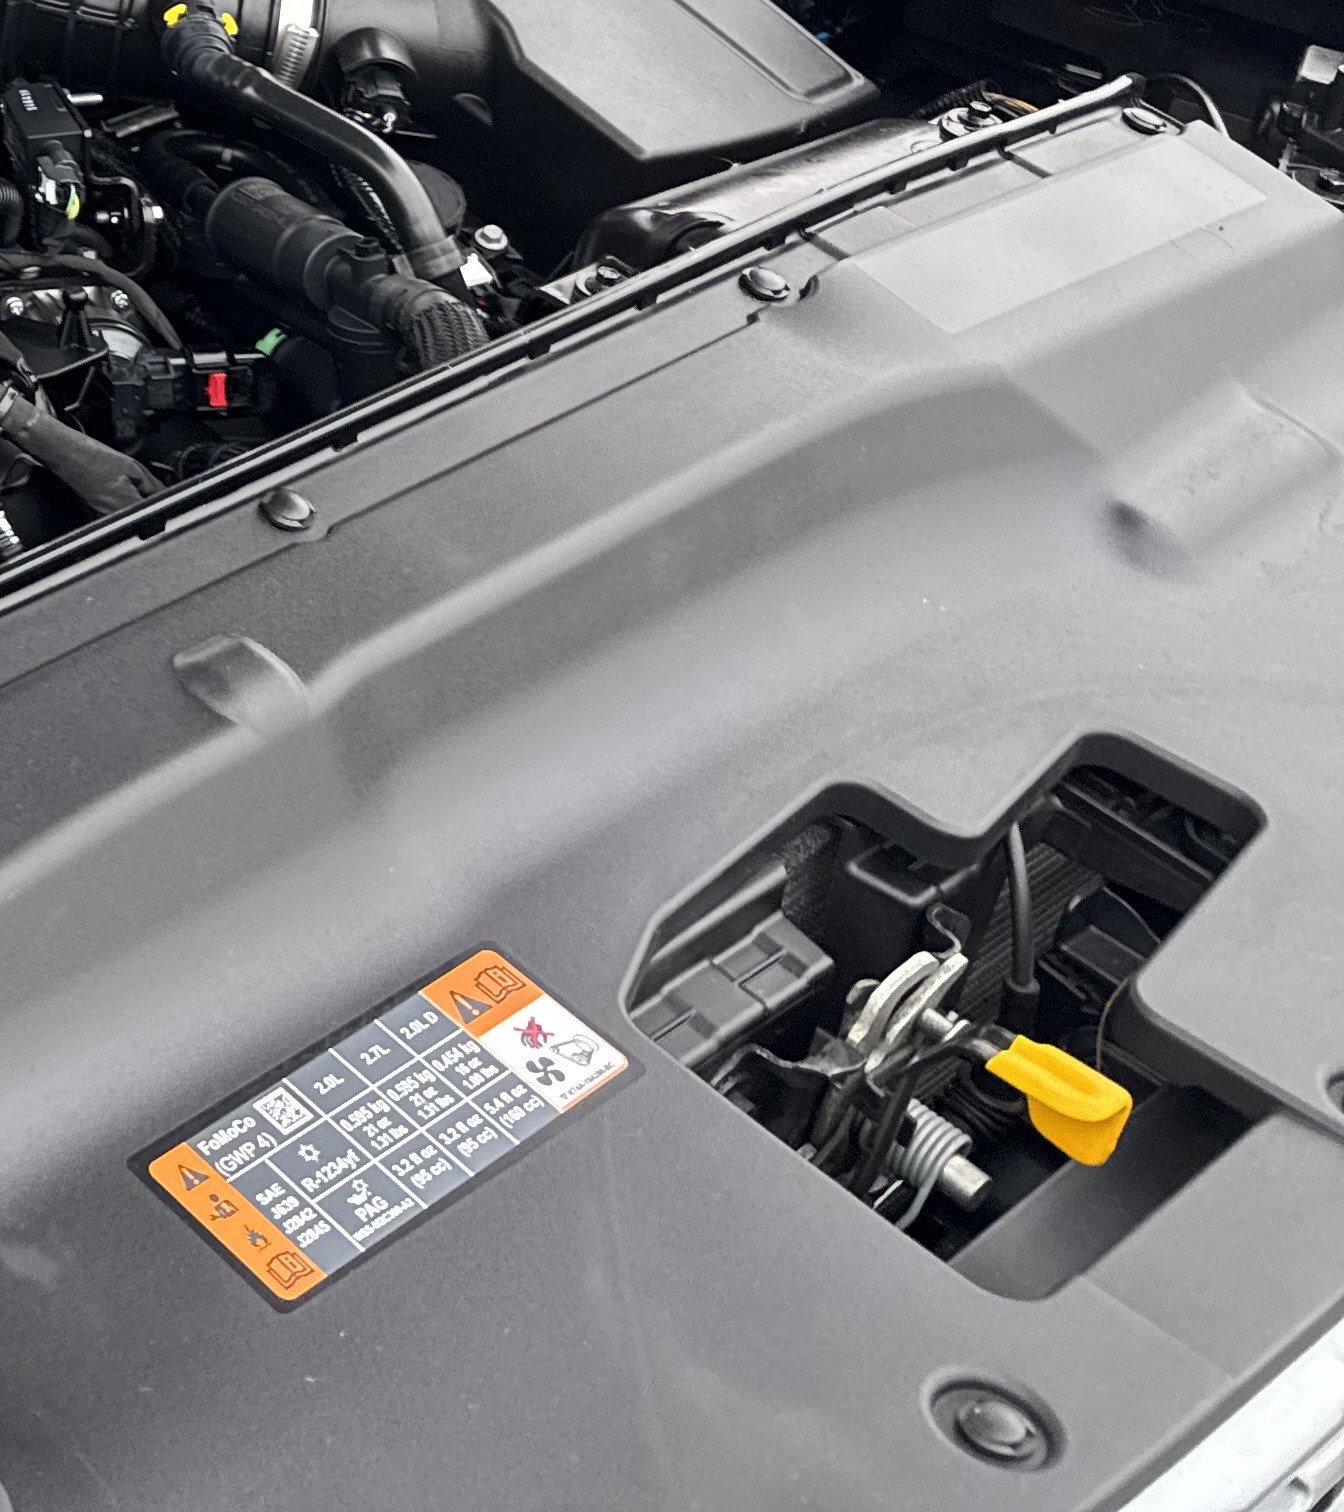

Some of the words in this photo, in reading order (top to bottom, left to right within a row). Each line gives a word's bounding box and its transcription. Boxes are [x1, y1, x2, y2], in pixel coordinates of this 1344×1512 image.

[422, 1011, 439, 1025] D
[359, 1044, 391, 1065] 2.7L
[431, 1049, 462, 1072] 0.454
[457, 1040, 481, 1055] kg
[313, 1074, 345, 1096] 2.0L
[411, 1069, 436, 1084] kg
[510, 1083, 528, 1098] oz
[366, 1098, 391, 1114] kg
[522, 1095, 545, 1113] cc)
[377, 1116, 393, 1130] oz
[438, 1127, 461, 1145] 3.2
[466, 1113, 484, 1128] oz
[197, 1116, 257, 1156] FoMoCo
[457, 1138, 481, 1157] (95
[476, 1127, 498, 1144] cc)
[214, 1142, 256, 1178] (GWP
[256, 1132, 278, 1148] 4)
[391, 1158, 415, 1177] 3.2
[419, 1144, 439, 1159] oz
[300, 1148, 361, 1193] R-1234yf
[411, 1170, 434, 1189] (95
[429, 1158, 452, 1176] cc)
[255, 1182, 286, 1206] SAE
[270, 1195, 300, 1220] J639
[353, 1195, 389, 1222] PAG
